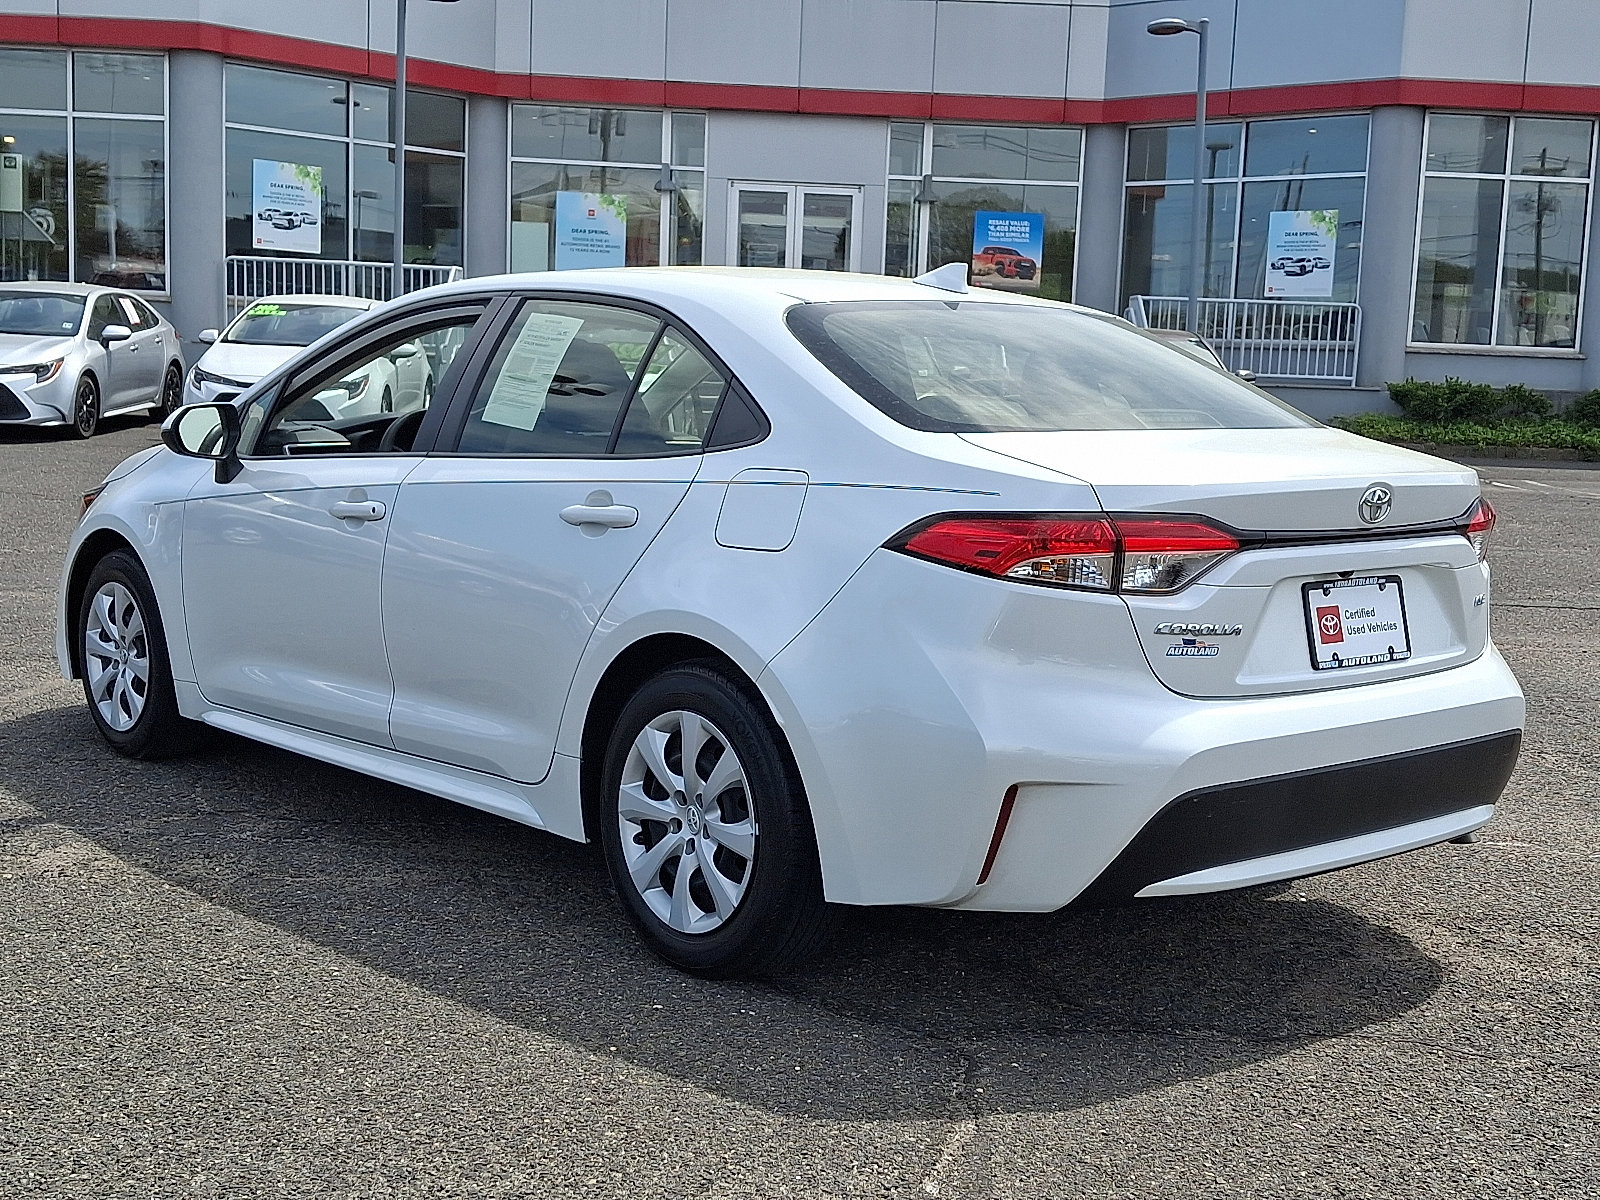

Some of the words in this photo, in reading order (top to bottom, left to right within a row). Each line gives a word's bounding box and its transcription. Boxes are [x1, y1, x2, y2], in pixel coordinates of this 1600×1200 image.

[1344, 606, 1376, 620] Certified
[1153, 621, 1243, 637] COROLLA
[1346, 624, 1366, 636] Used
[1366, 620, 1398, 634] Vehicles
[1167, 646, 1219, 656] AUTOLAND
[1341, 653, 1391, 668] AUTOLAND
